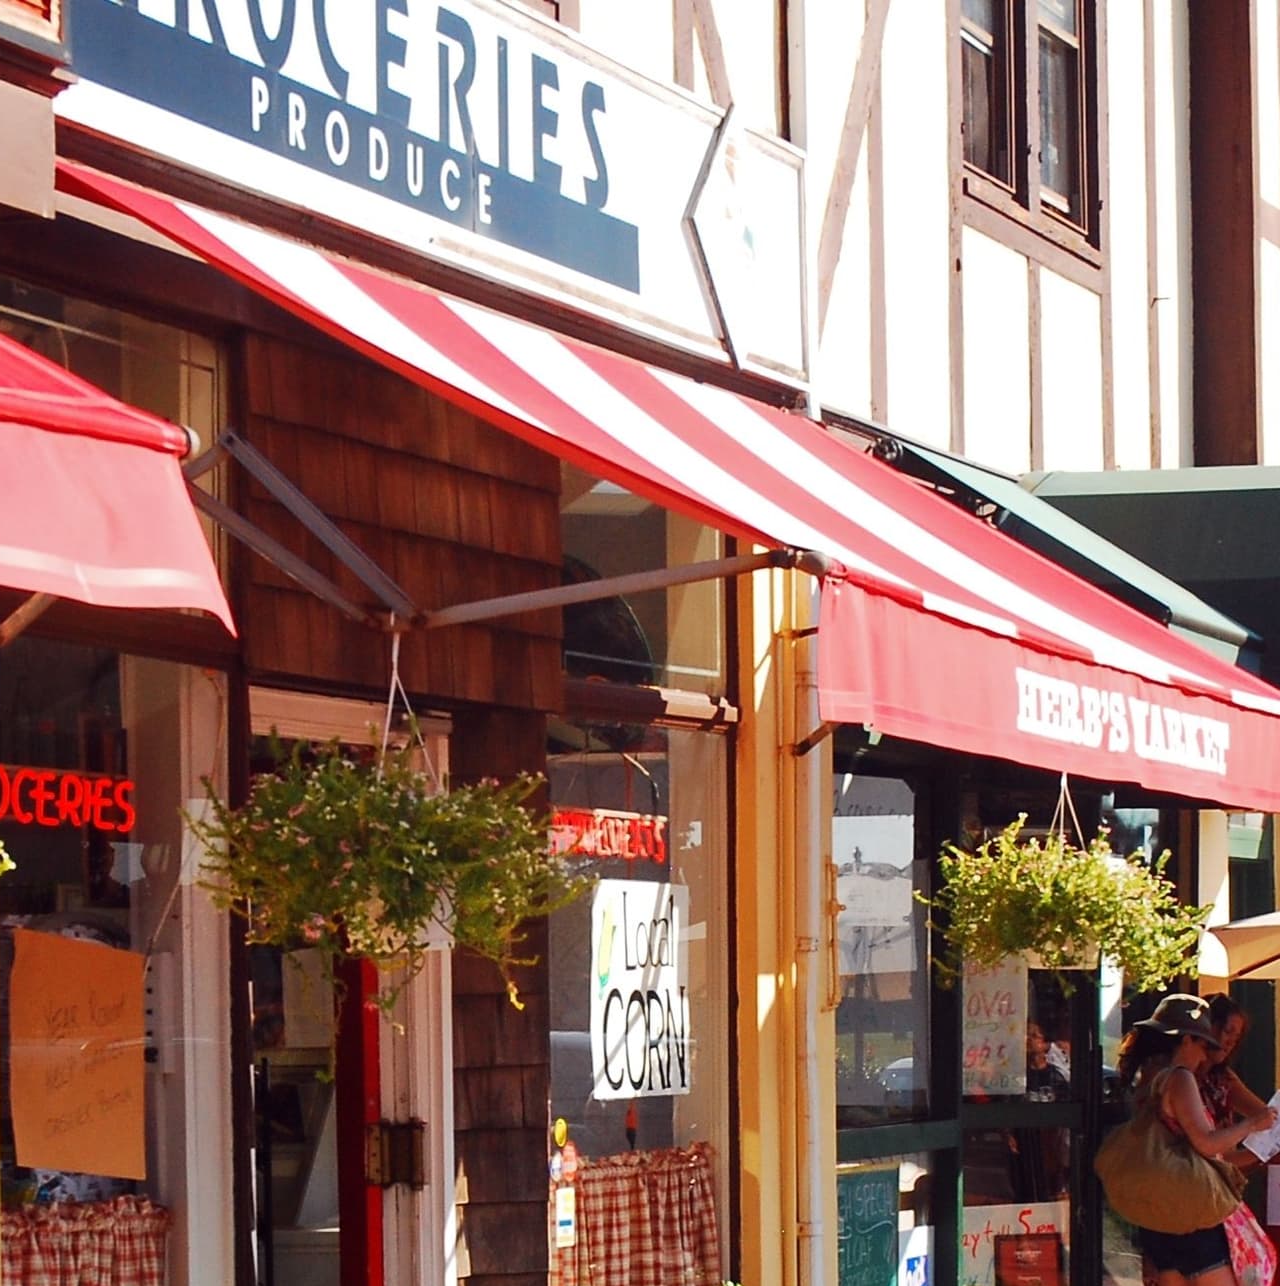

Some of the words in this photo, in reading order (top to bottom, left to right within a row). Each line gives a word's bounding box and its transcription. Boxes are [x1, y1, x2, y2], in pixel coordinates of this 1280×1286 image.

[251, 77, 493, 226] PRODUCE
[1015, 666, 1131, 754] HERB'S
[622, 891, 675, 972] Local
[602, 985, 688, 1093] CORN
